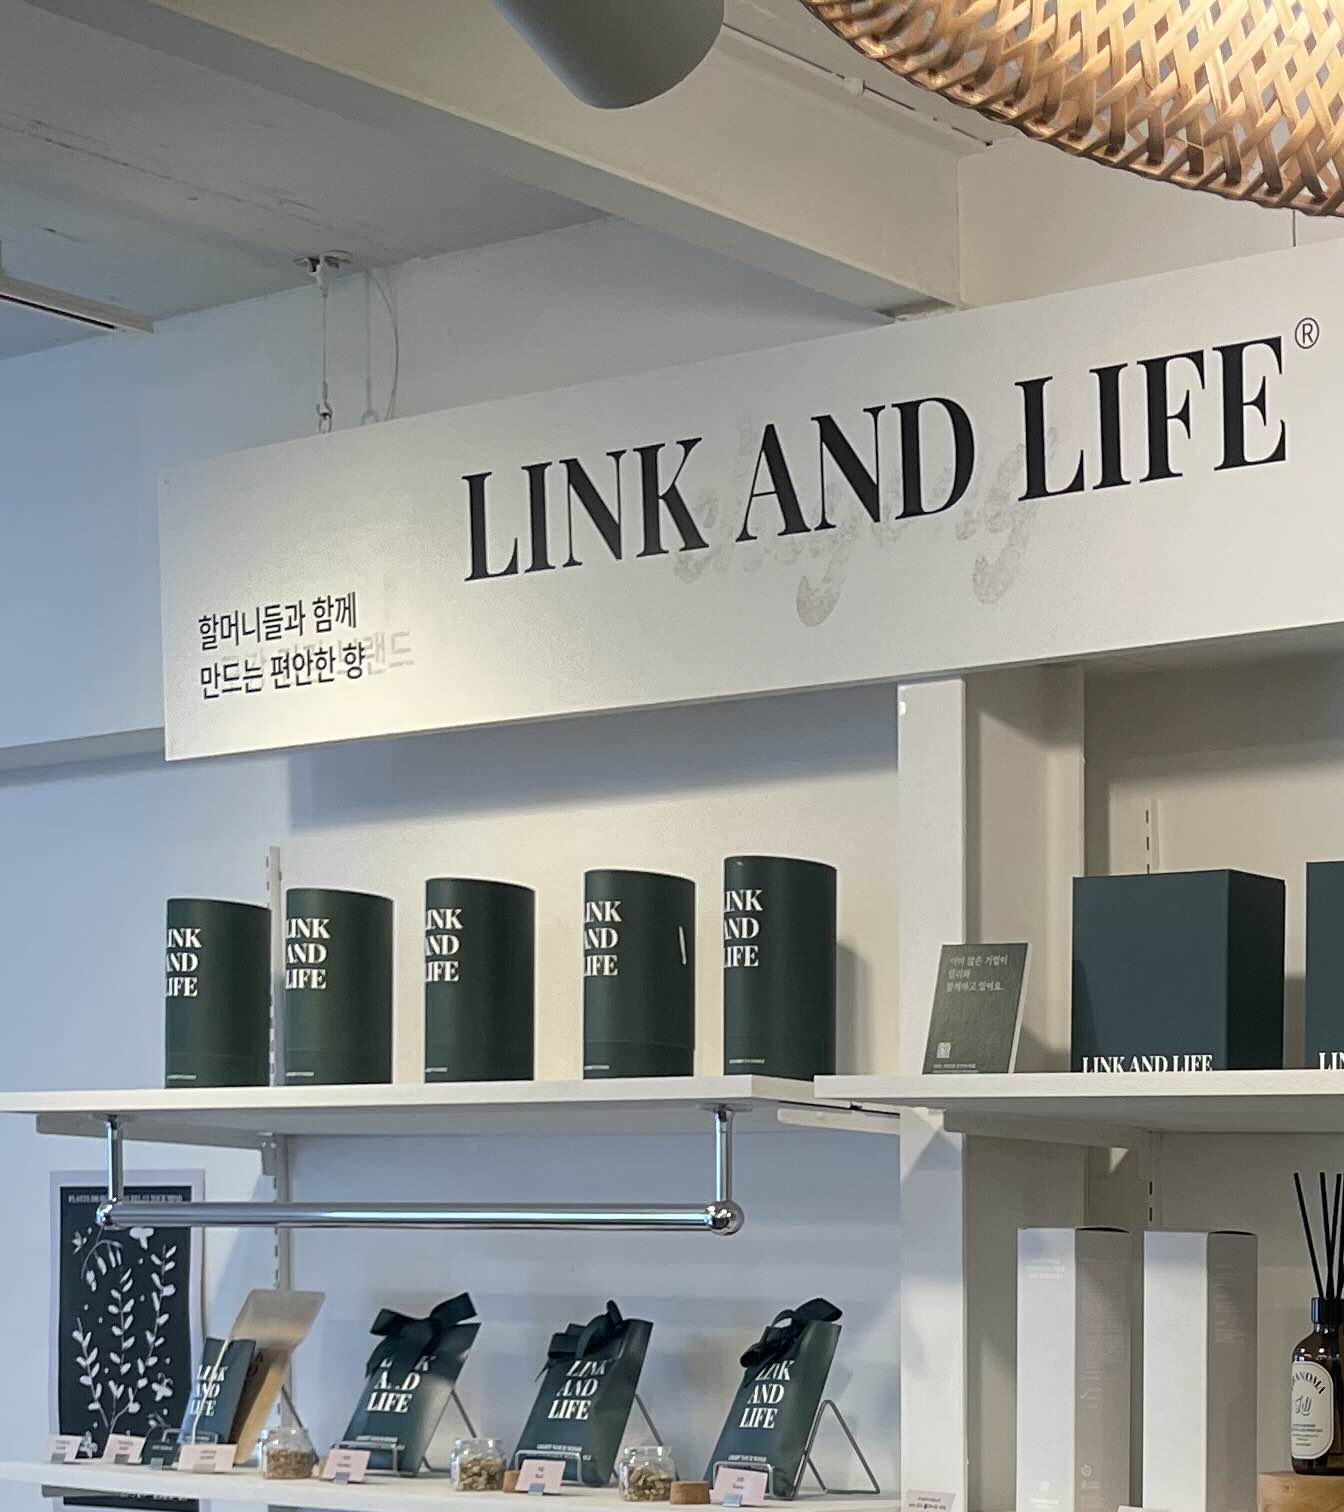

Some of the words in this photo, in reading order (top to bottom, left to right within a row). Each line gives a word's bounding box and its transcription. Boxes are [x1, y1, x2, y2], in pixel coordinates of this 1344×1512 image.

[461, 436, 710, 582] LINK
[735, 396, 976, 542] AND
[1014, 336, 1288, 503] LIFE
[198, 599, 306, 651] 할머니들과
[311, 591, 357, 634] 함께
[200, 658, 264, 700] 만드는
[270, 645, 337, 690] 편안한
[342, 641, 367, 680] 향
[1082, 1055, 1125, 1073] LINK
[1129, 1055, 1169, 1073] AND
[1172, 1054, 1214, 1072] LIFE
[374, 1371, 421, 1391] AD
[556, 1378, 599, 1397] AND
[1292, 1371, 1326, 1395] ANDMA
[367, 1391, 413, 1413] LIFE
[747, 1383, 785, 1405] AND
[547, 1399, 592, 1420] LIFE
[739, 1407, 779, 1429] LIFE
